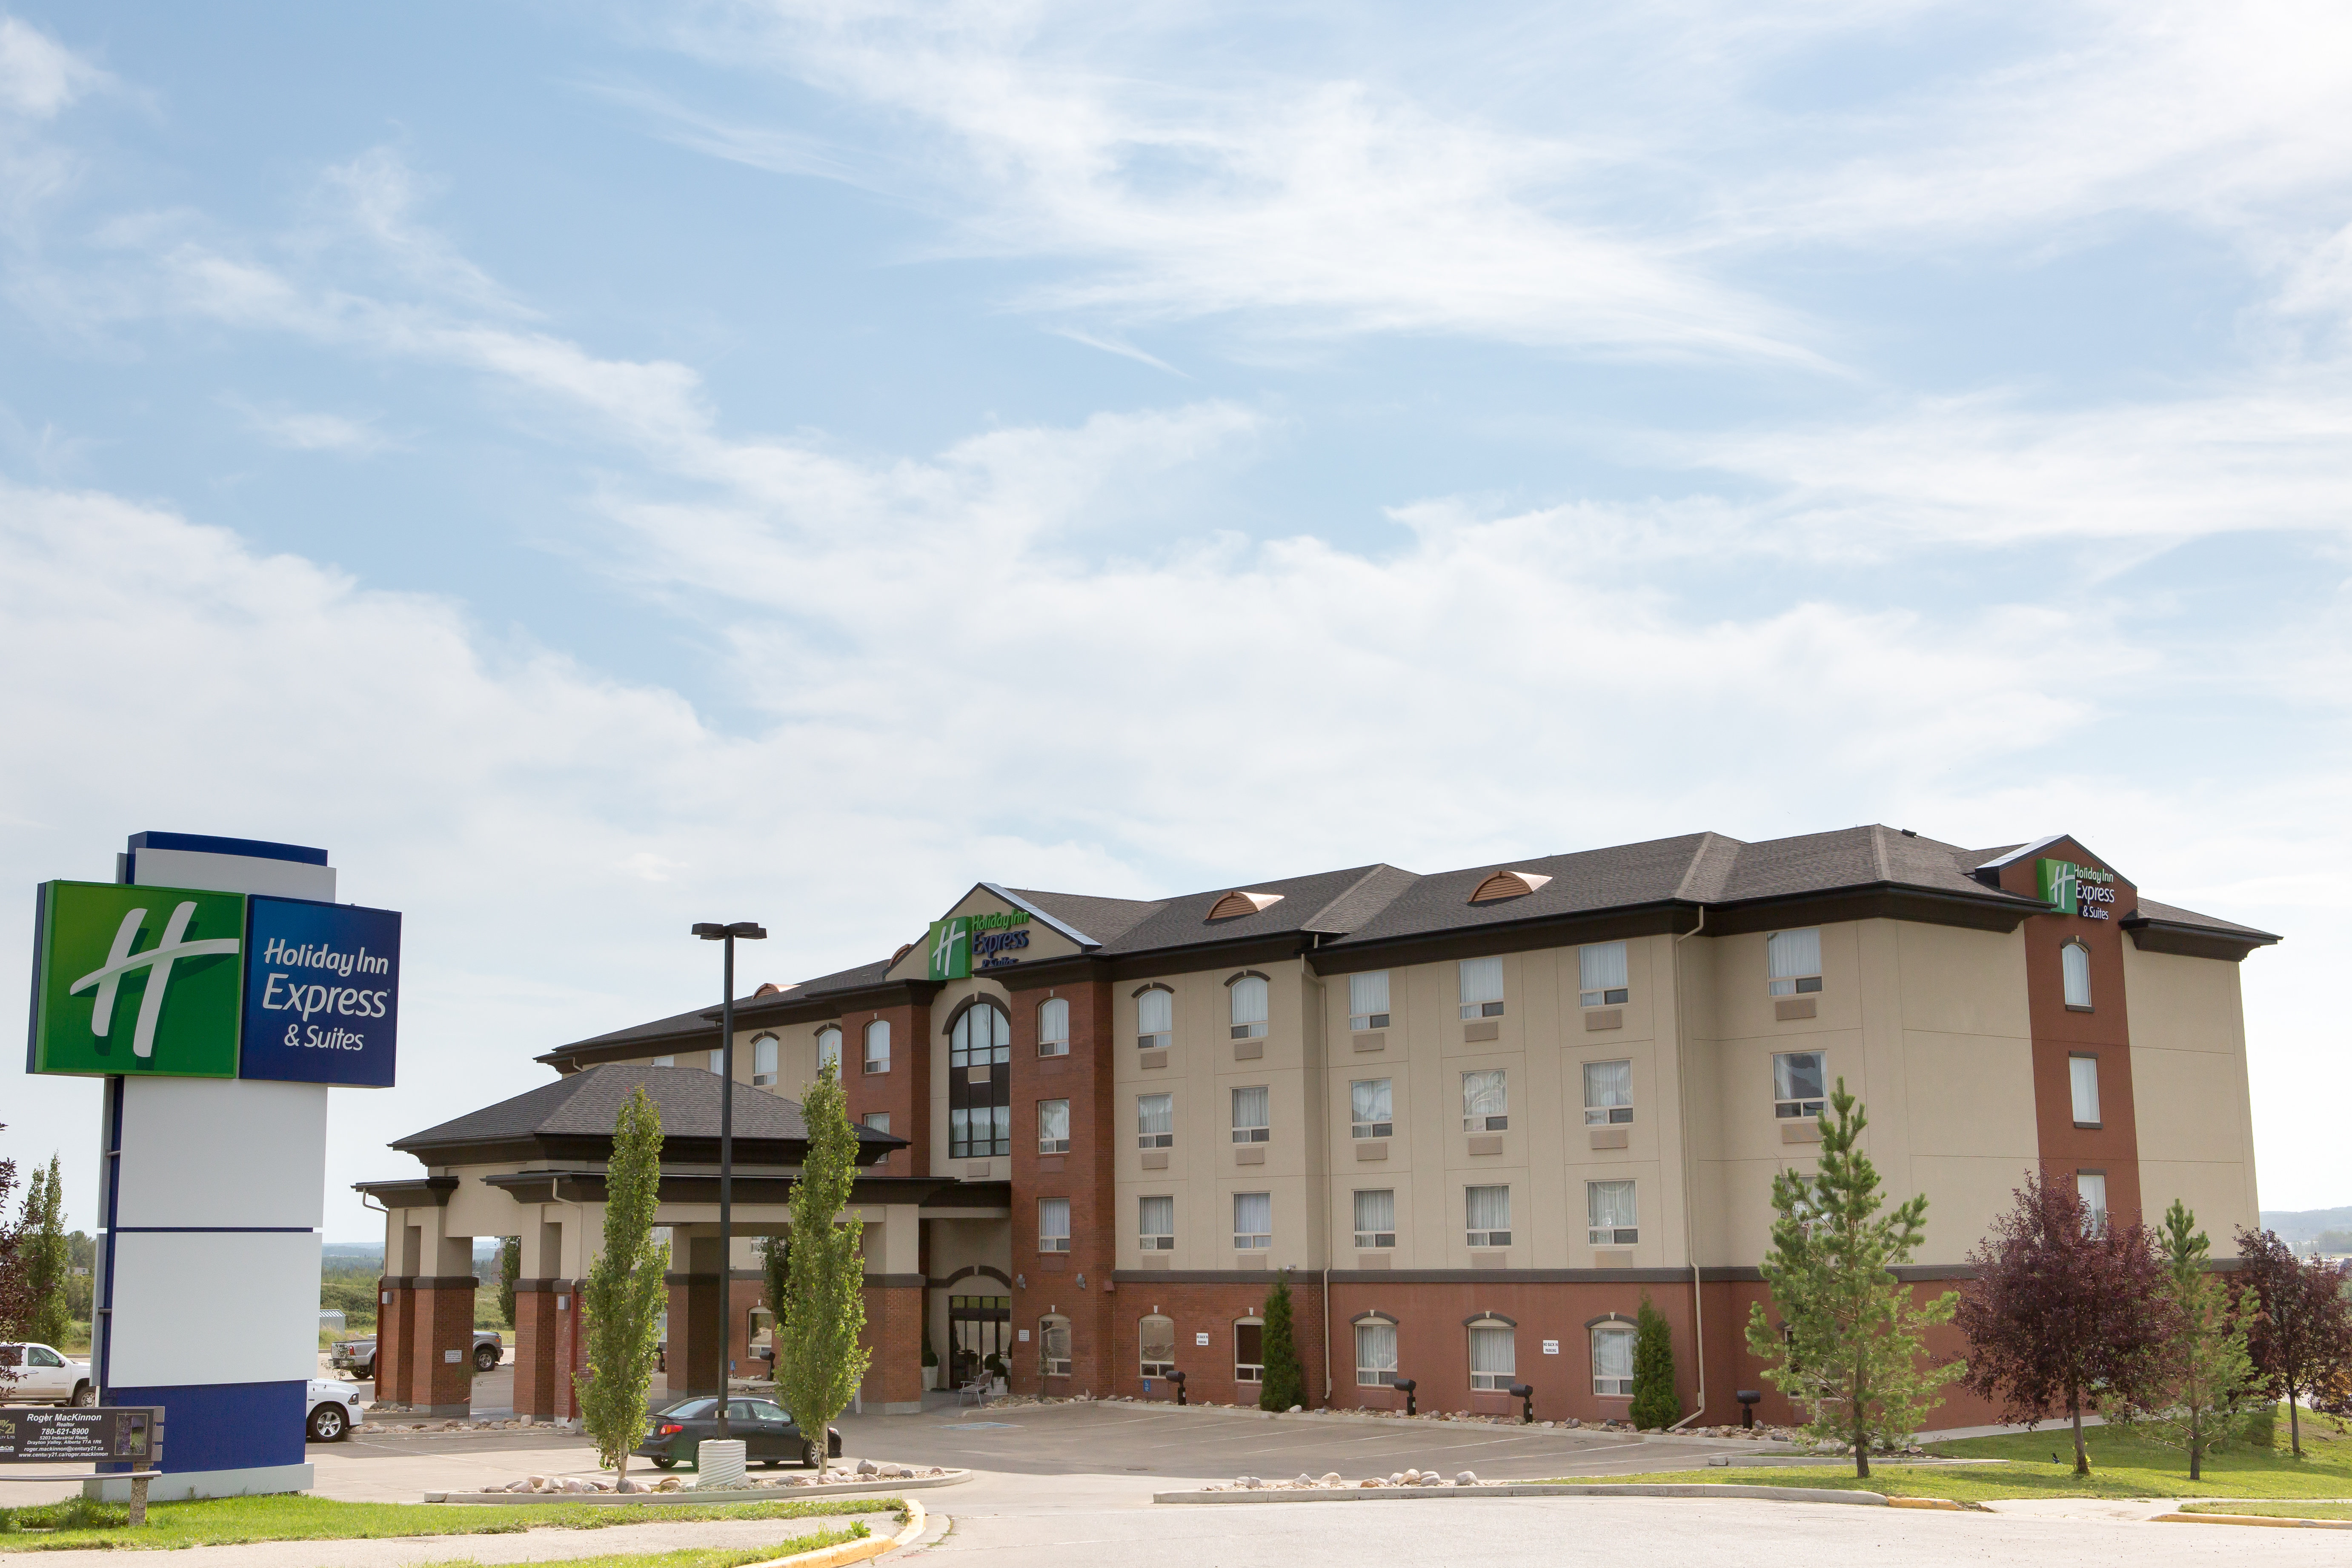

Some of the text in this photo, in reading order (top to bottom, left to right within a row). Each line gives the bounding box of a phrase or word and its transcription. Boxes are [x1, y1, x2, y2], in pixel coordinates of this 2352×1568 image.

[2074, 864, 2114, 884] Holiday Inn
[2076, 880, 2115, 905] Express
[972, 909, 1030, 931] Holiday Inn
[2083, 905, 2109, 920] & Suites
[972, 930, 1030, 959] Express
[264, 938, 389, 977] Holiday Inn
[284, 1024, 364, 1051] & Suites
[5, 1423, 16, 1434] 21
[26, 1413, 102, 1423] Roger MacKinnon
